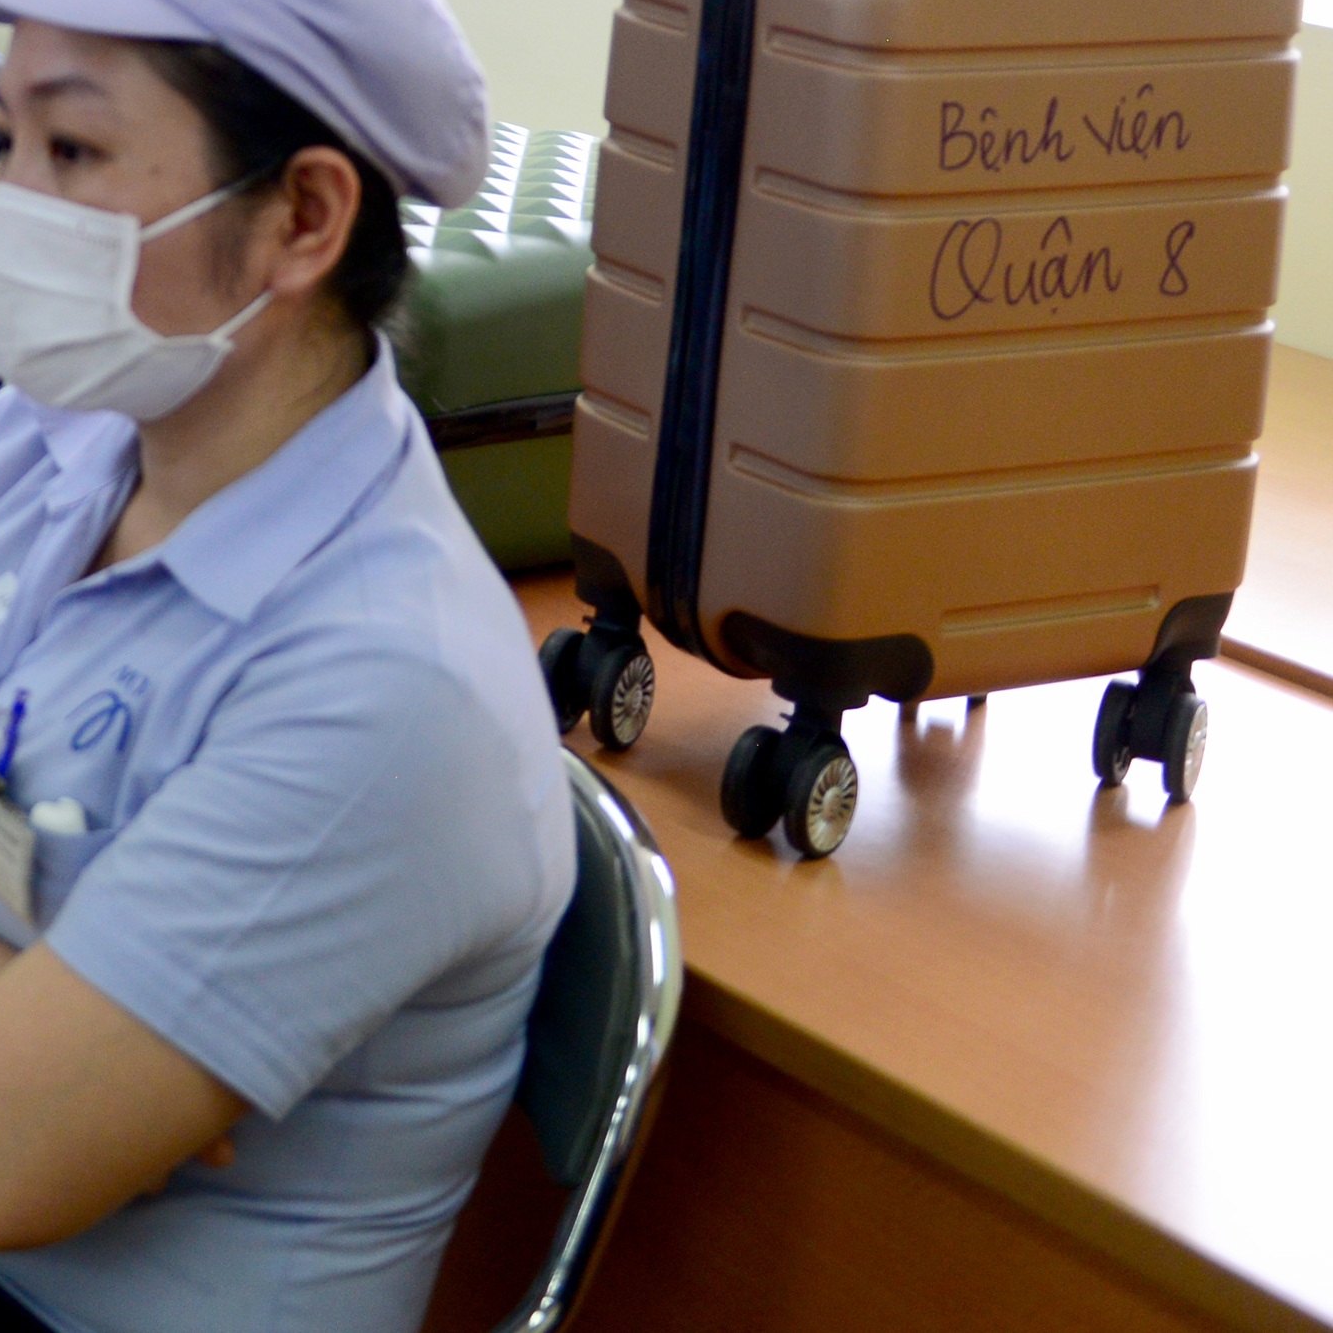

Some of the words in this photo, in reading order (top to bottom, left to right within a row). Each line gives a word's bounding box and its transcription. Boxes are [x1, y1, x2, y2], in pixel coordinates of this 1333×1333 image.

[938, 96, 1076, 173] Bệnh
[929, 216, 1123, 320] Quận
[1159, 220, 1195, 297] 8
